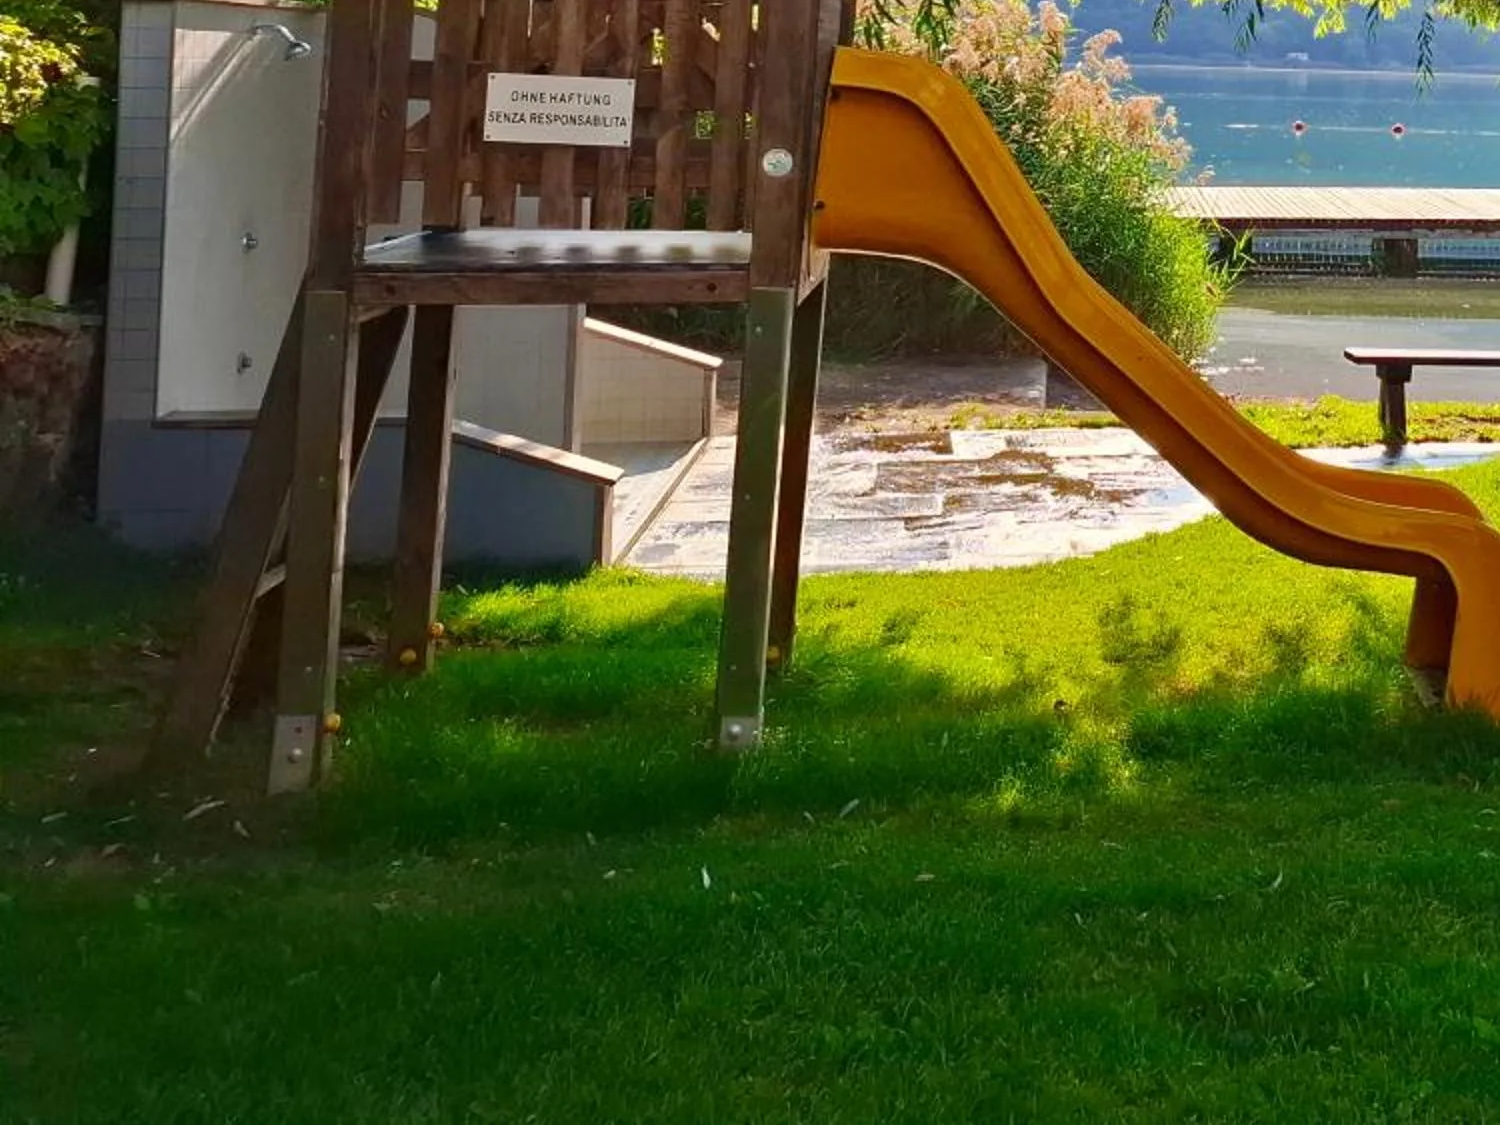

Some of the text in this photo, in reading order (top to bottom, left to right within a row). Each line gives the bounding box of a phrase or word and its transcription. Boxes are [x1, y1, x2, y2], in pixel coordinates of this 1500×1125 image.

[511, 90, 611, 106] OHNE HAFTUNG
[488, 111, 526, 124] SENZA
